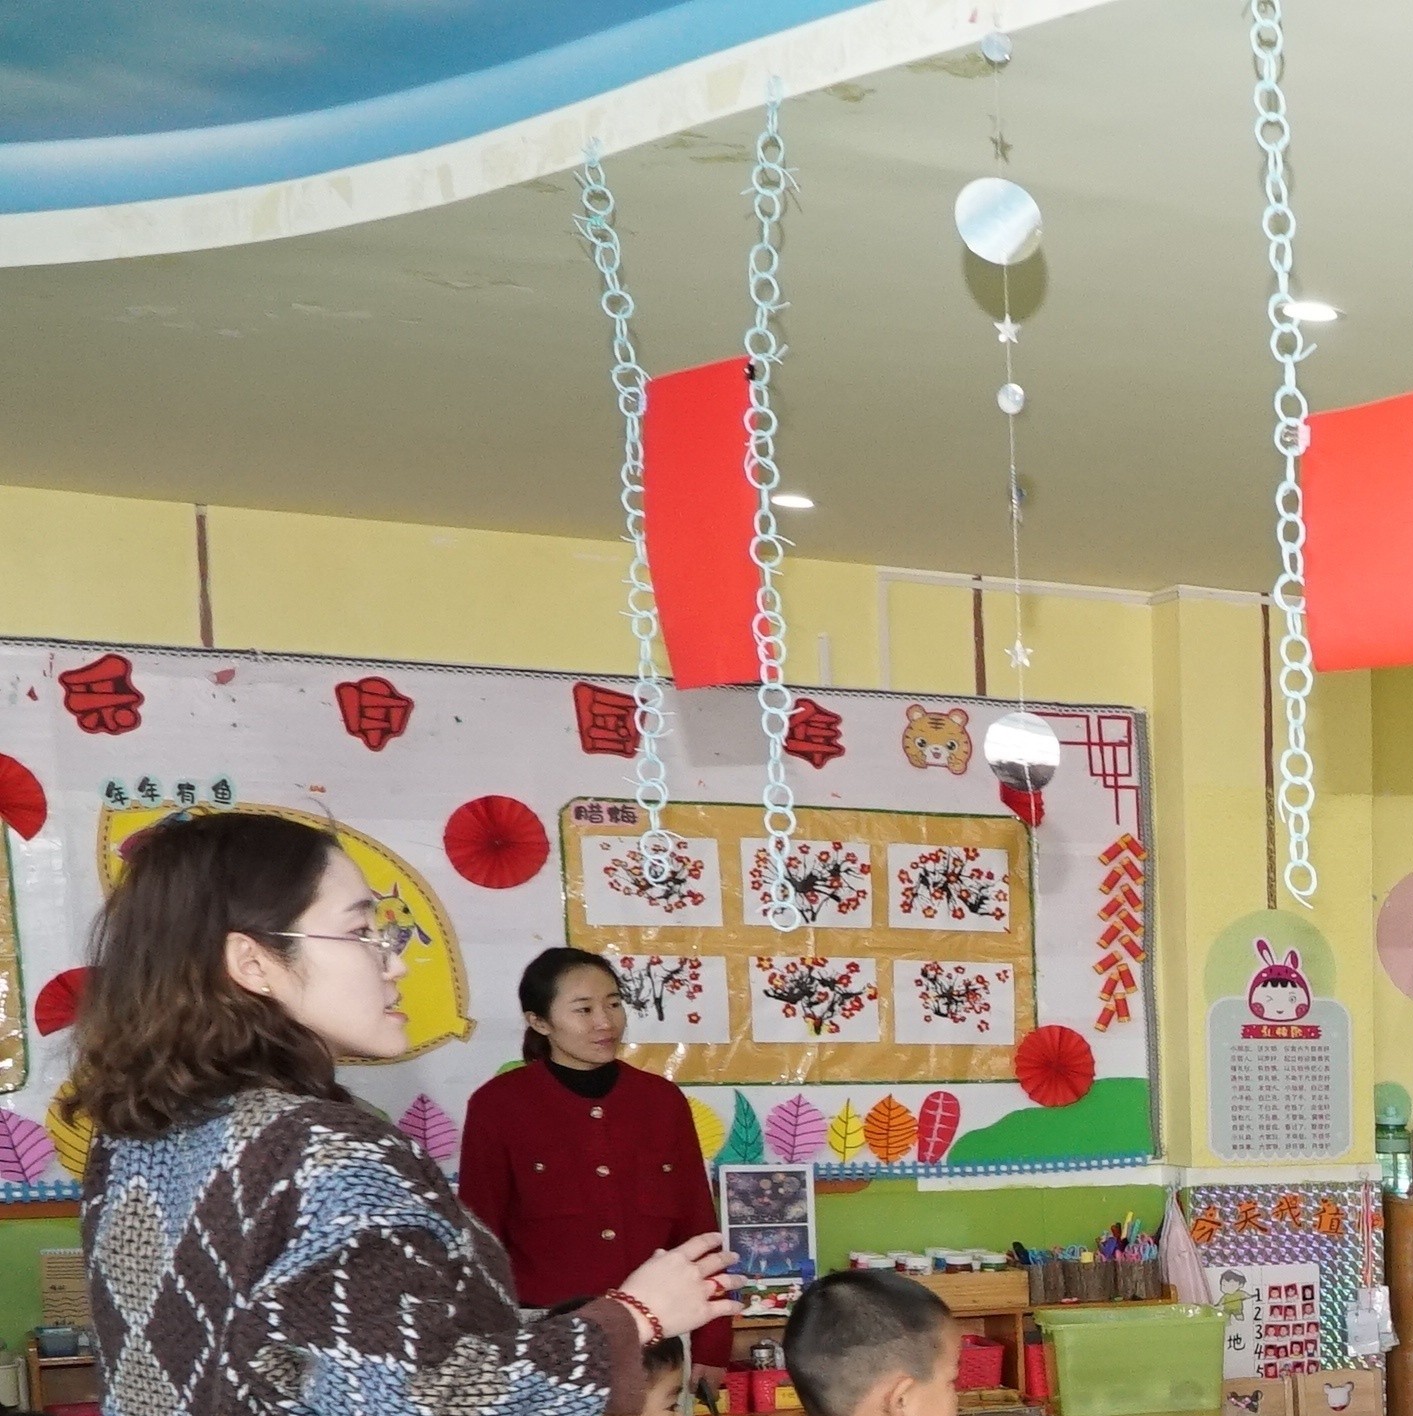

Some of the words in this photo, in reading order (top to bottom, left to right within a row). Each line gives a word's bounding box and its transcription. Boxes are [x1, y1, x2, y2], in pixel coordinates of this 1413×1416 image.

[104, 776, 233, 805] 年年有鱼
[1253, 1307, 1263, 1321] 2
[1255, 1325, 1263, 1340] 3
[1227, 1333, 1246, 1351] 地
[1254, 1345, 1264, 1360] 4
[1256, 1363, 1264, 1378] 5
